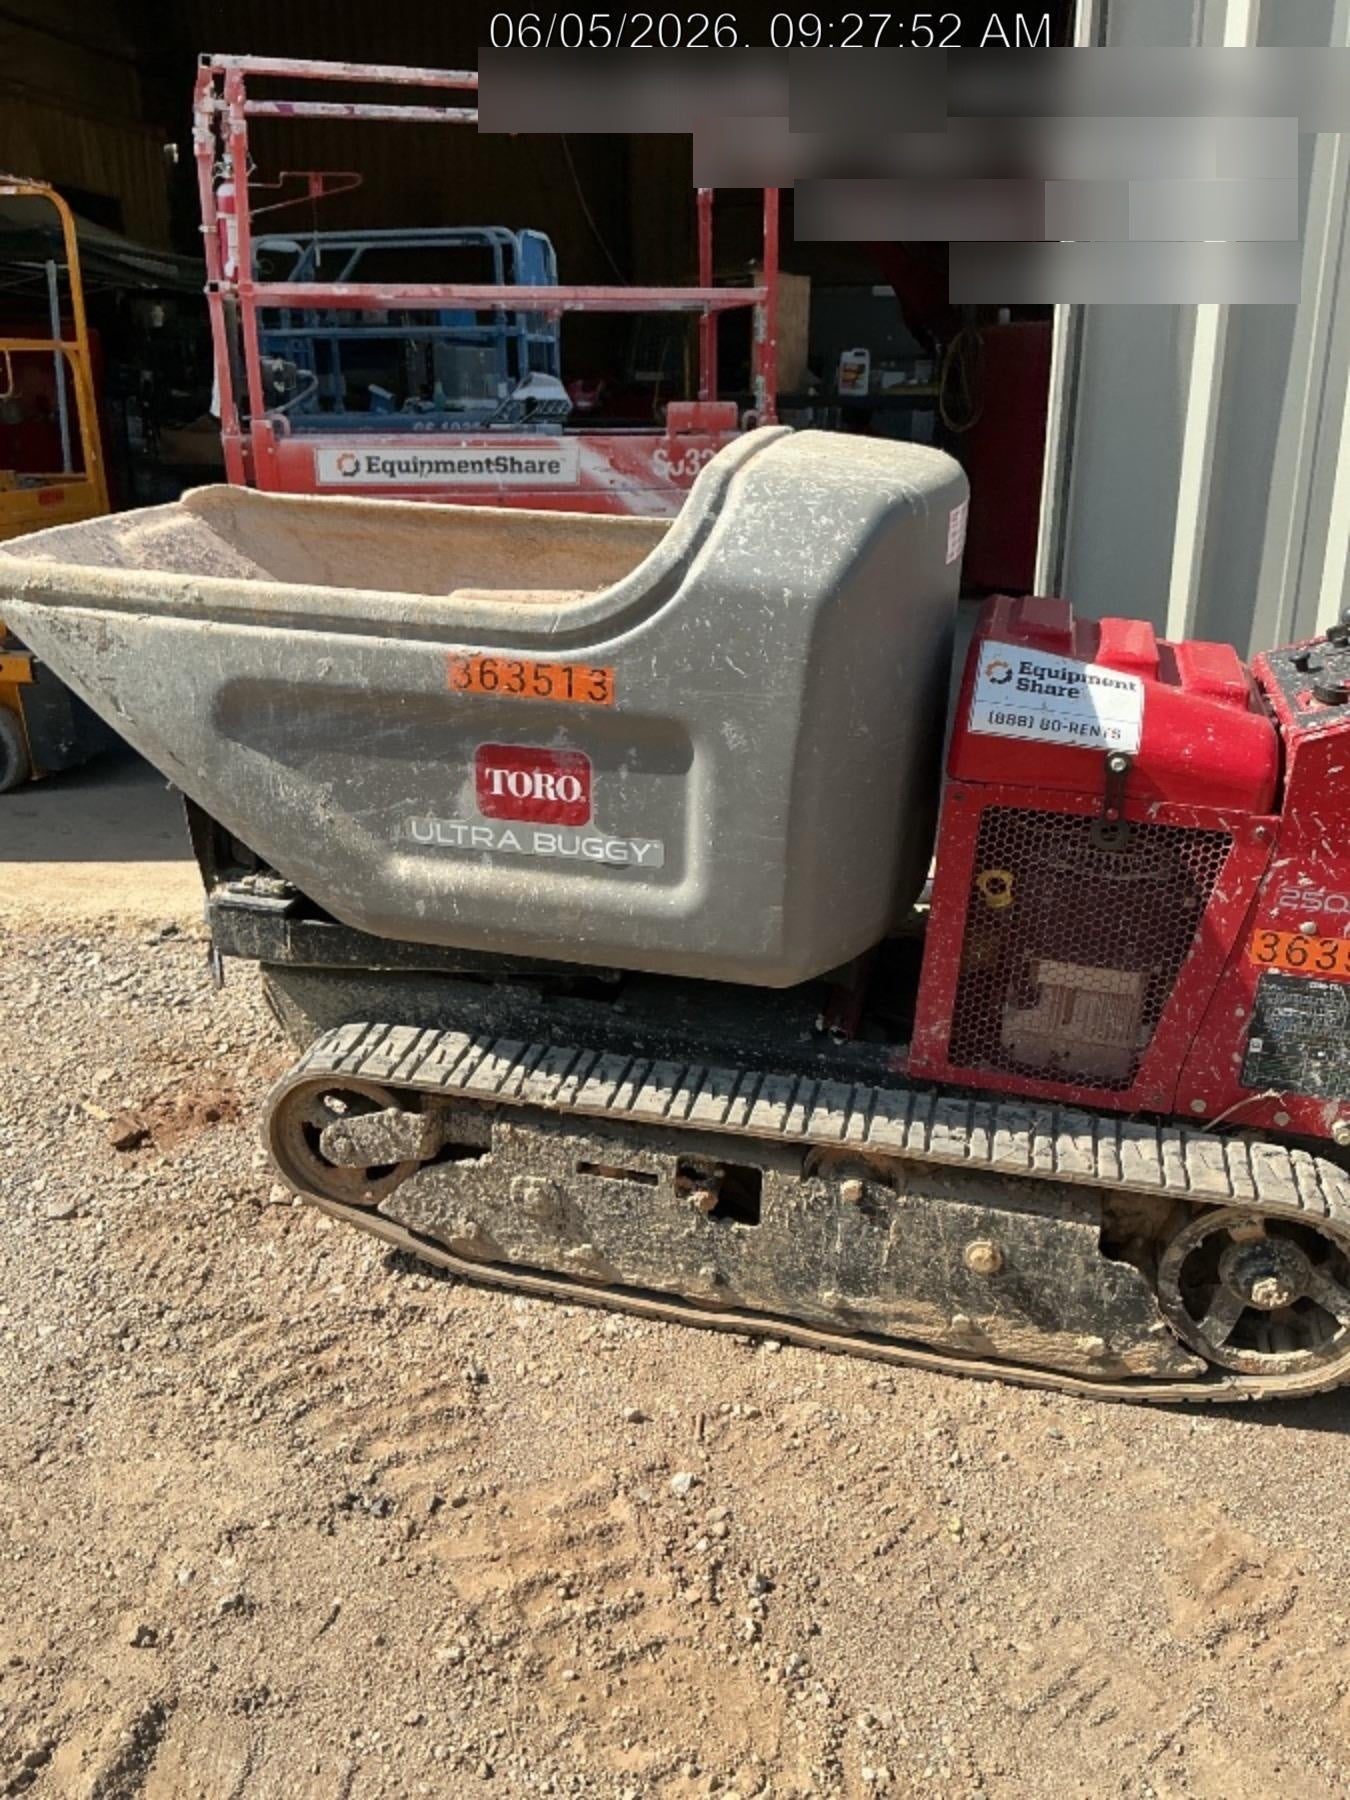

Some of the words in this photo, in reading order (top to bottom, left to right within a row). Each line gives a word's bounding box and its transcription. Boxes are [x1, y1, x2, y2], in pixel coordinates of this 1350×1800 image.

[365, 455, 561, 478] EquipmentShare
[452, 658, 610, 701] 363513
[1015, 678, 1080, 699] Share
[1018, 661, 1137, 692] Equipment
[485, 768, 583, 801] TORO
[411, 821, 521, 851] ULTRA
[533, 832, 651, 863] BUGGY
